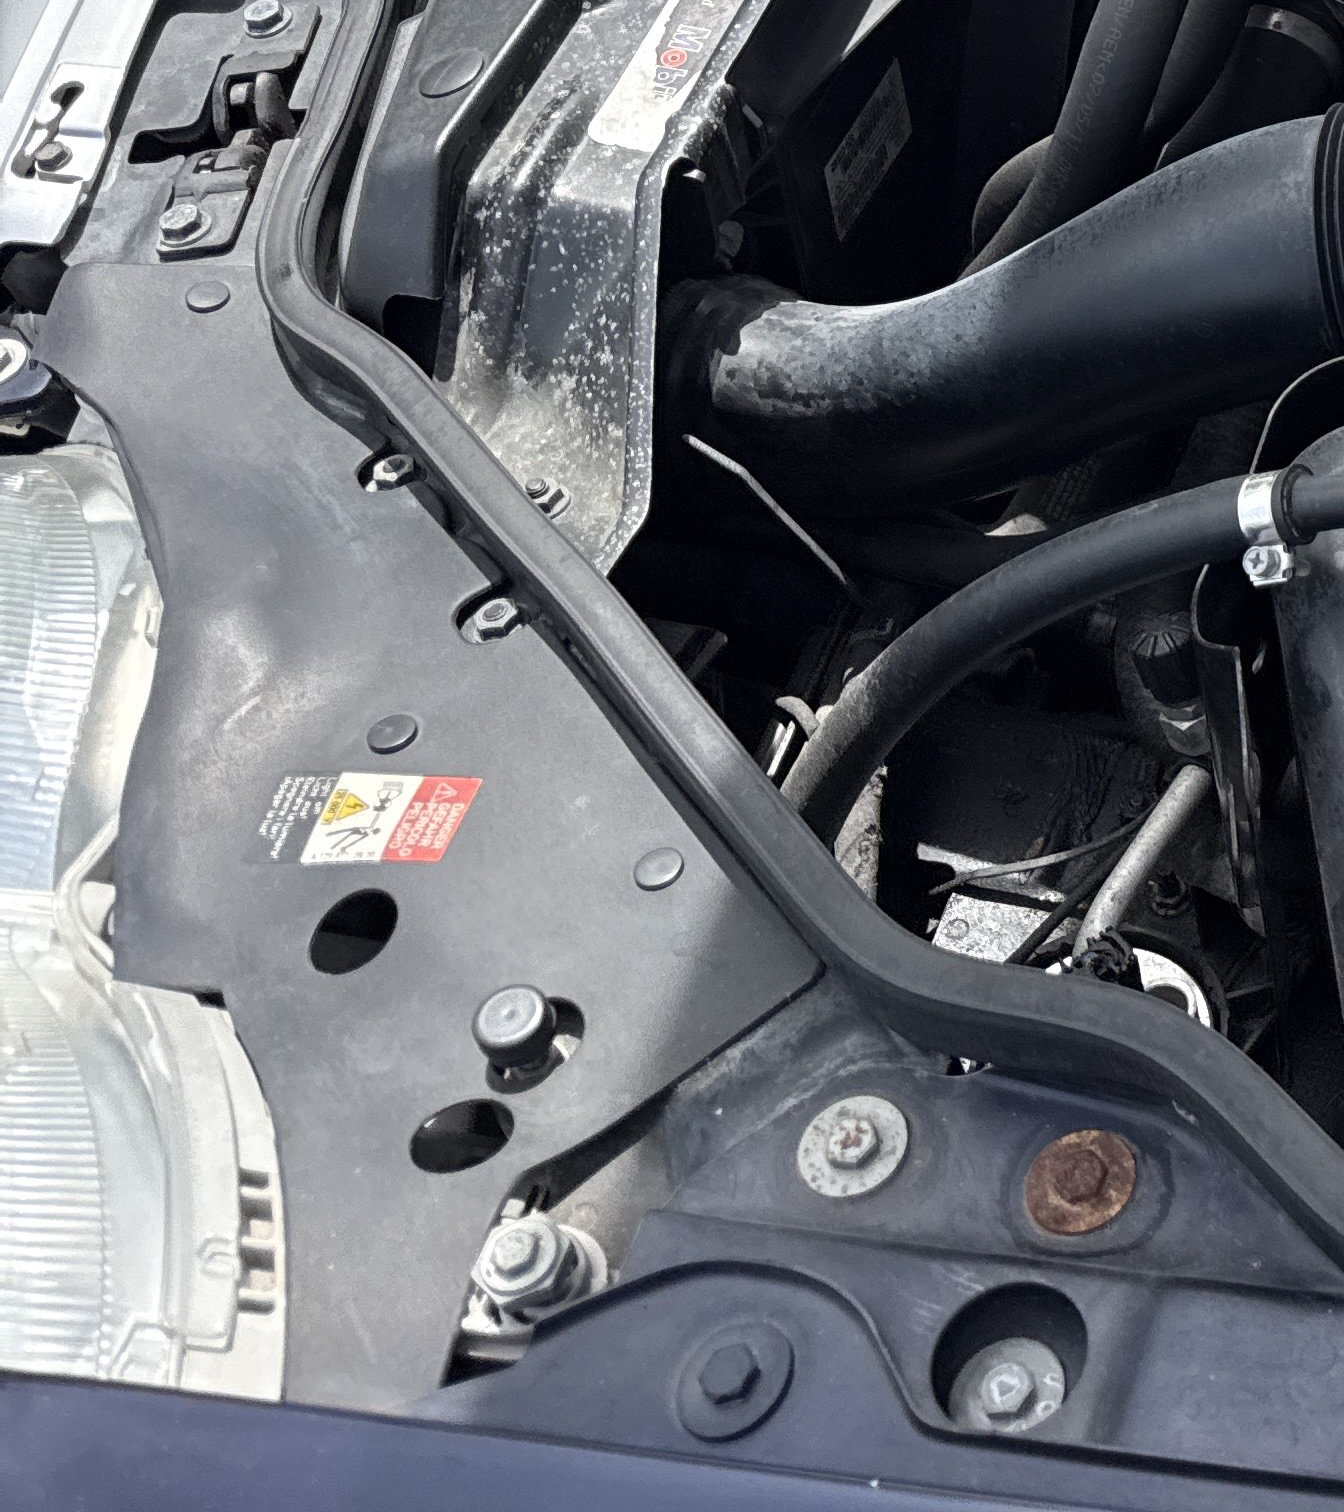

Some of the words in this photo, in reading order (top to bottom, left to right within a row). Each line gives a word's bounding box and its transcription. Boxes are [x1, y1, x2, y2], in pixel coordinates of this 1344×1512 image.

[388, 801, 423, 850] PELIGRO
[399, 802, 437, 857] PERICOLO
[417, 801, 449, 848] GEFAHR
[432, 802, 465, 850] DANGER
